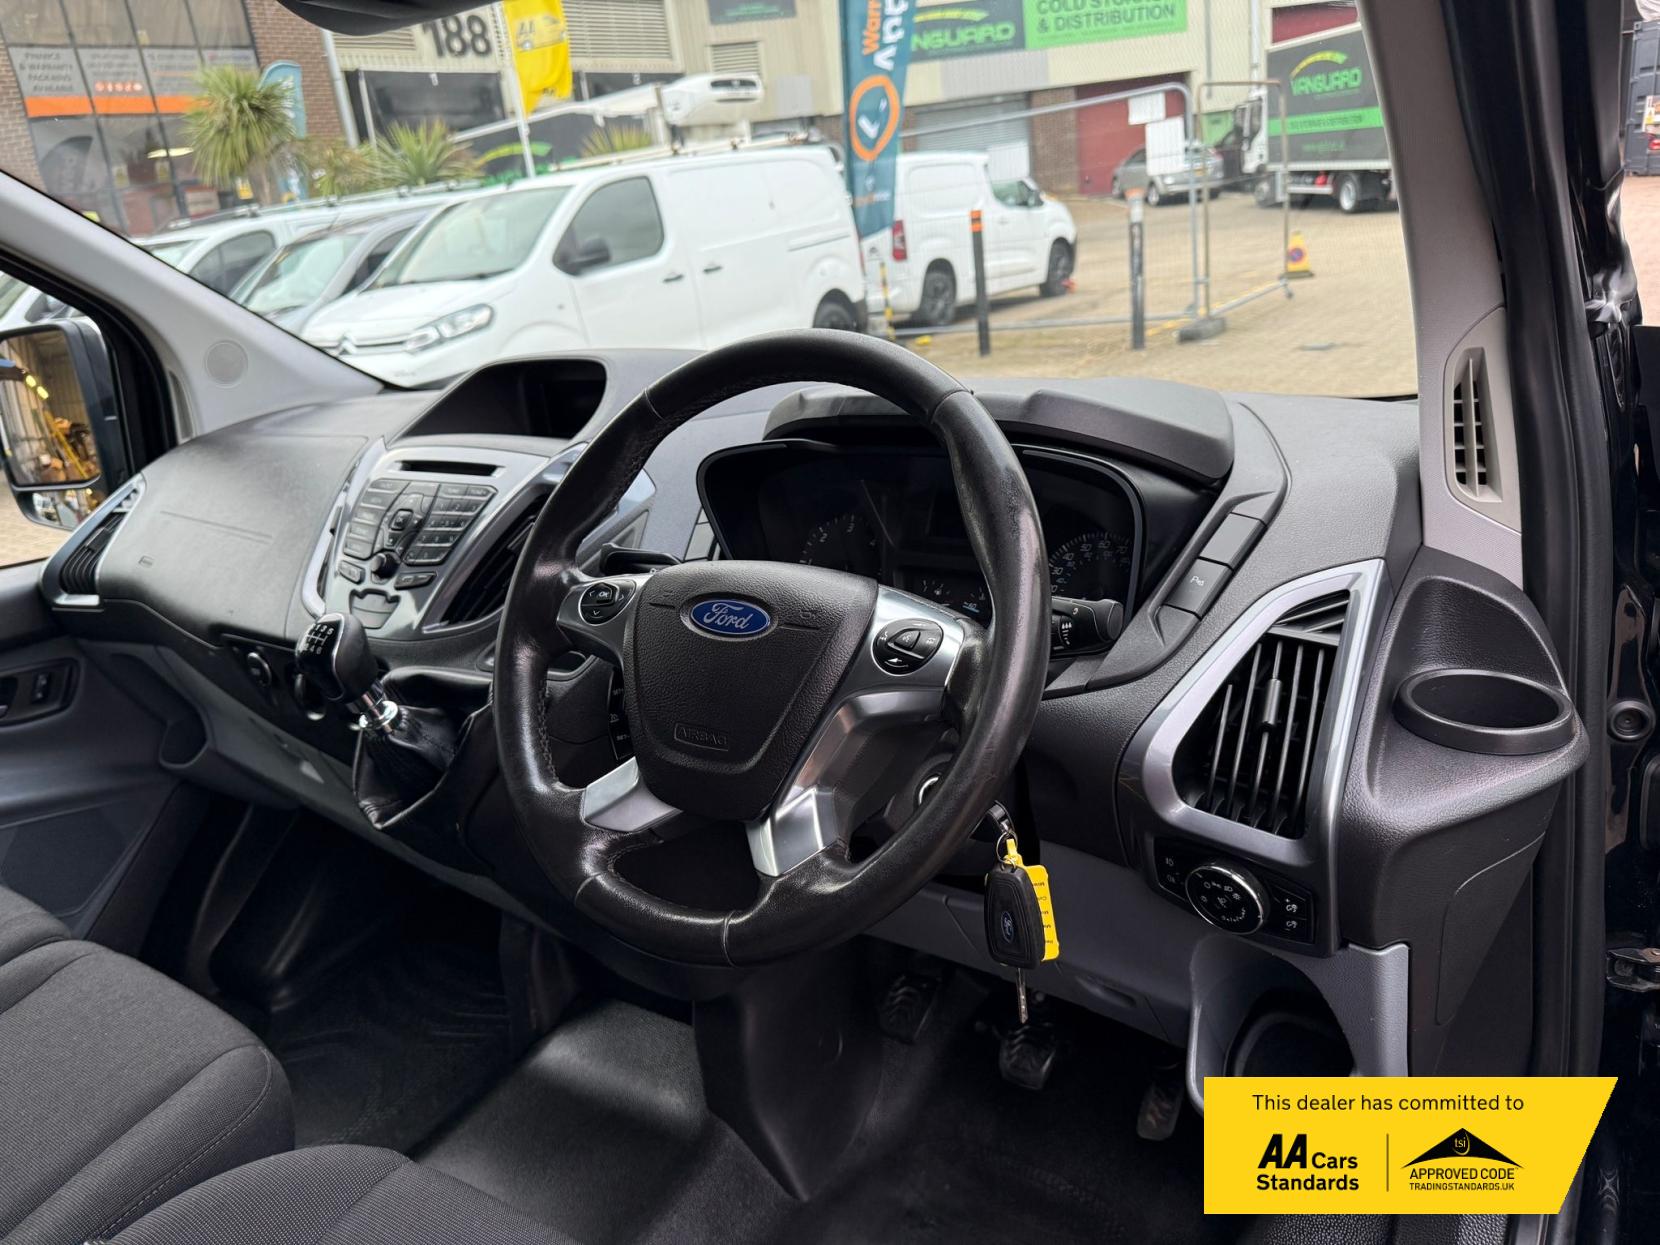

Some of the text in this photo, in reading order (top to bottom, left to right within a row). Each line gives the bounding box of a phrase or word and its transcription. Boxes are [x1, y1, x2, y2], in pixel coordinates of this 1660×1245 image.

[1037, 17, 1049, 33] &
[1054, 4, 1176, 31] DISTRIBUTION
[422, 14, 491, 57] 188
[704, 602, 754, 629] Ford
